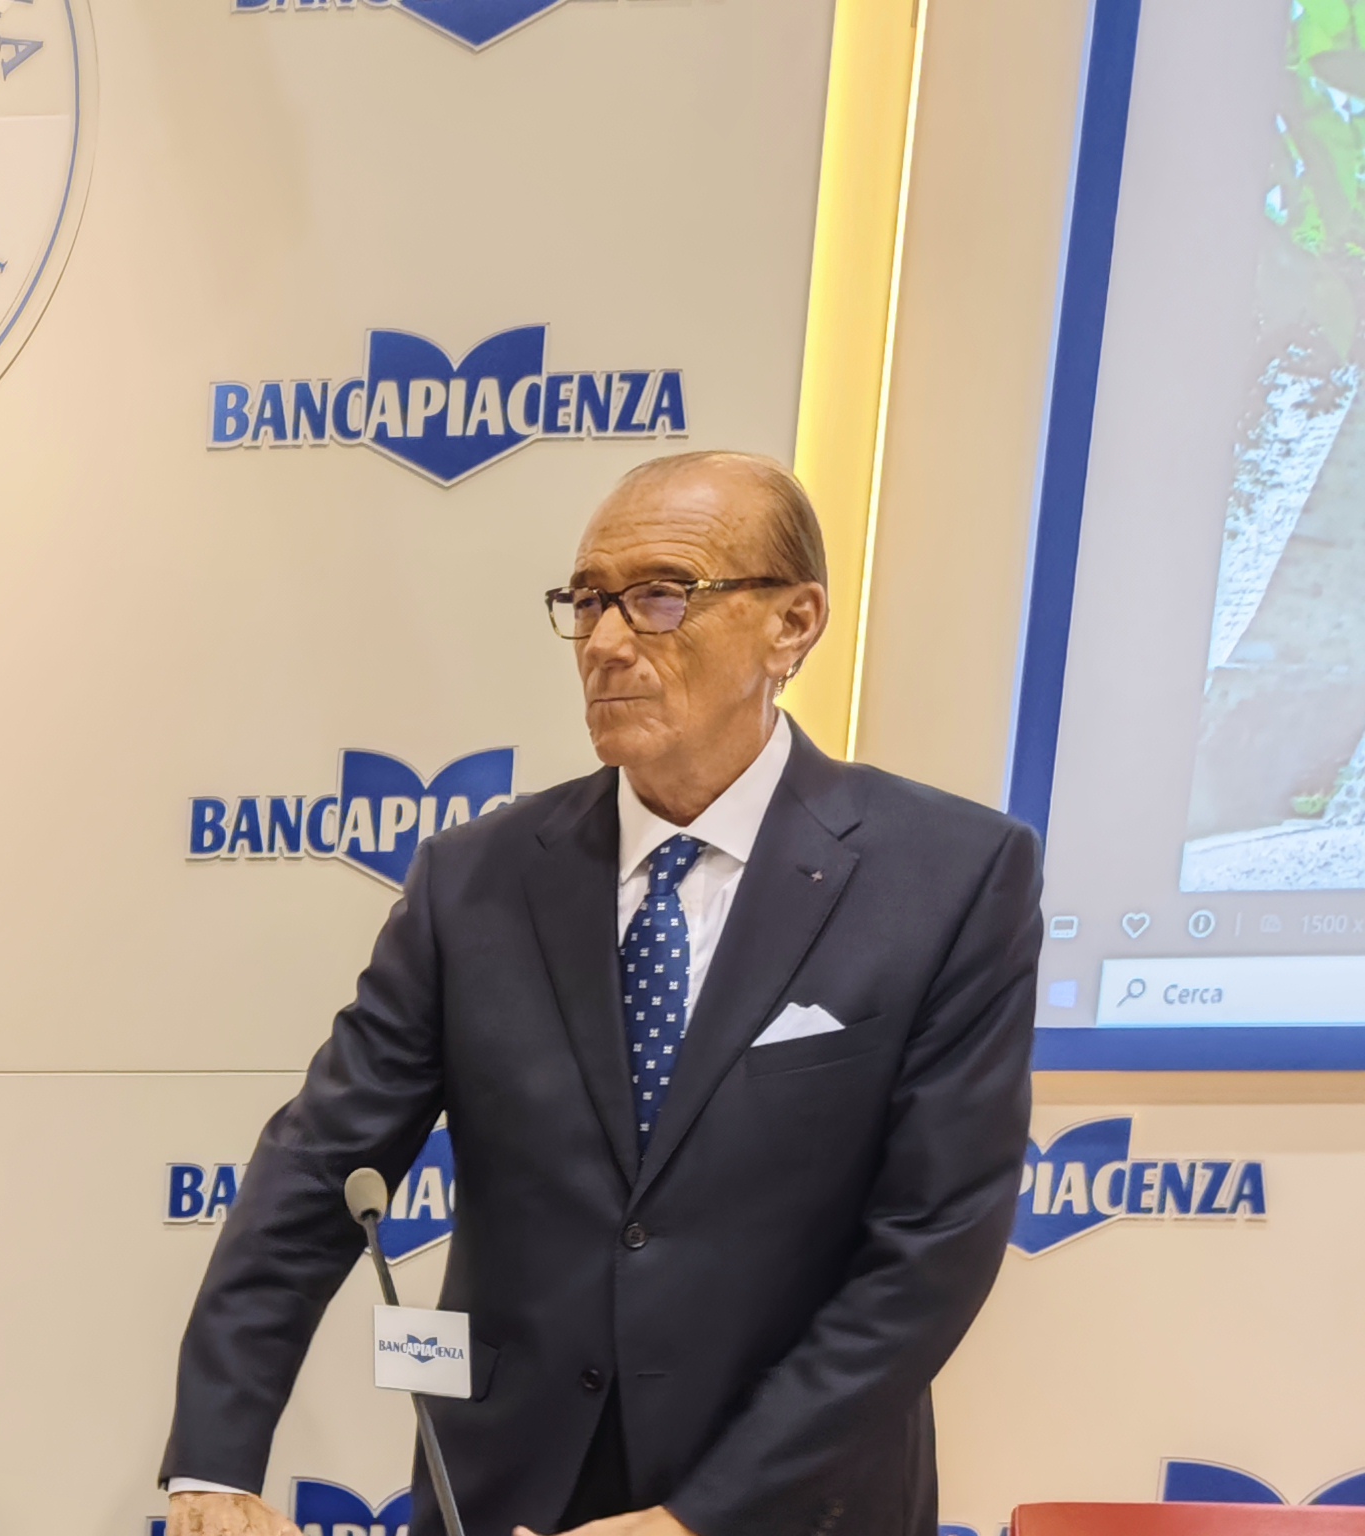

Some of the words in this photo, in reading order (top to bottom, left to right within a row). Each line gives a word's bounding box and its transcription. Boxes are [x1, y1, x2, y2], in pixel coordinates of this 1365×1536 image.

[211, 371, 687, 443] BANCAPIACENZA
[1163, 984, 1224, 1006] Cerca
[379, 1340, 463, 1359] BANCAPIACENZA
